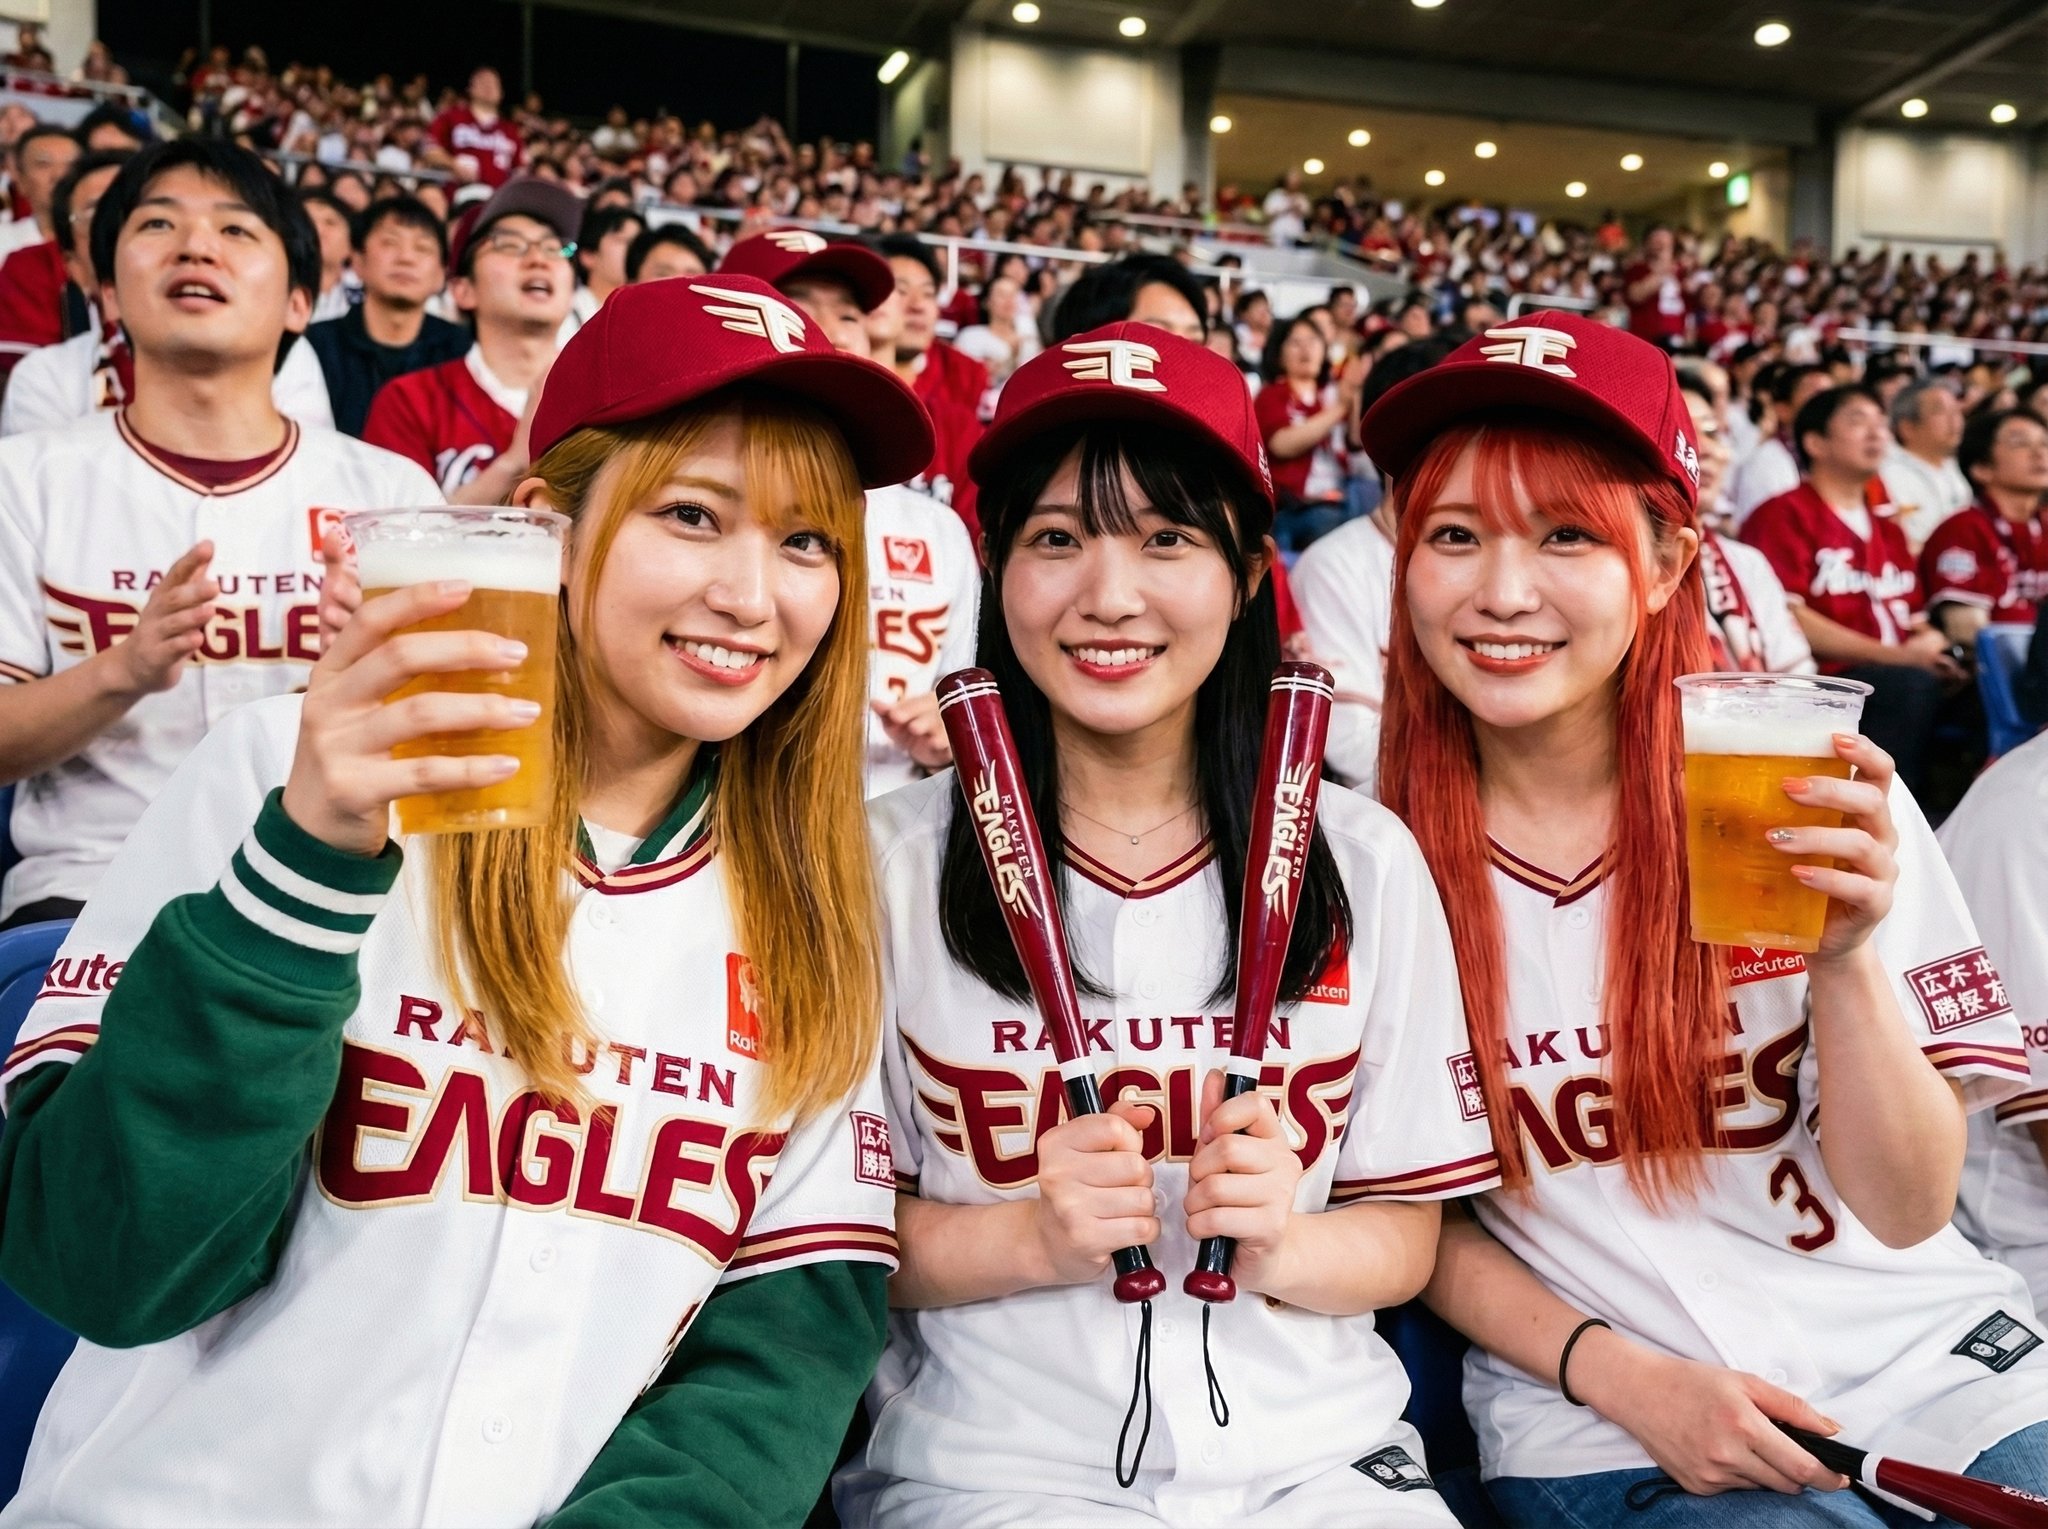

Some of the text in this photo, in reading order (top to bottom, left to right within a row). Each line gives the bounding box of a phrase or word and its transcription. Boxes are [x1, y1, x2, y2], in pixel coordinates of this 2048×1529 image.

[44, 582, 321, 664] EGLE
[113, 571, 323, 593] RAUTEN
[973, 759, 1043, 919] EAGLES
[1001, 794, 1034, 878] RAKUTEN
[1261, 761, 1316, 925] EAGLES
[1292, 796, 1312, 879] RAKUTEN
[44, 953, 128, 992] kute
[1306, 984, 1348, 1000] uten
[393, 994, 737, 1108] RAUTEN
[315, 1038, 790, 1269] EAGLES
[899, 1030, 1362, 1190] EGLS
[1769, 1155, 1837, 1253] 3
